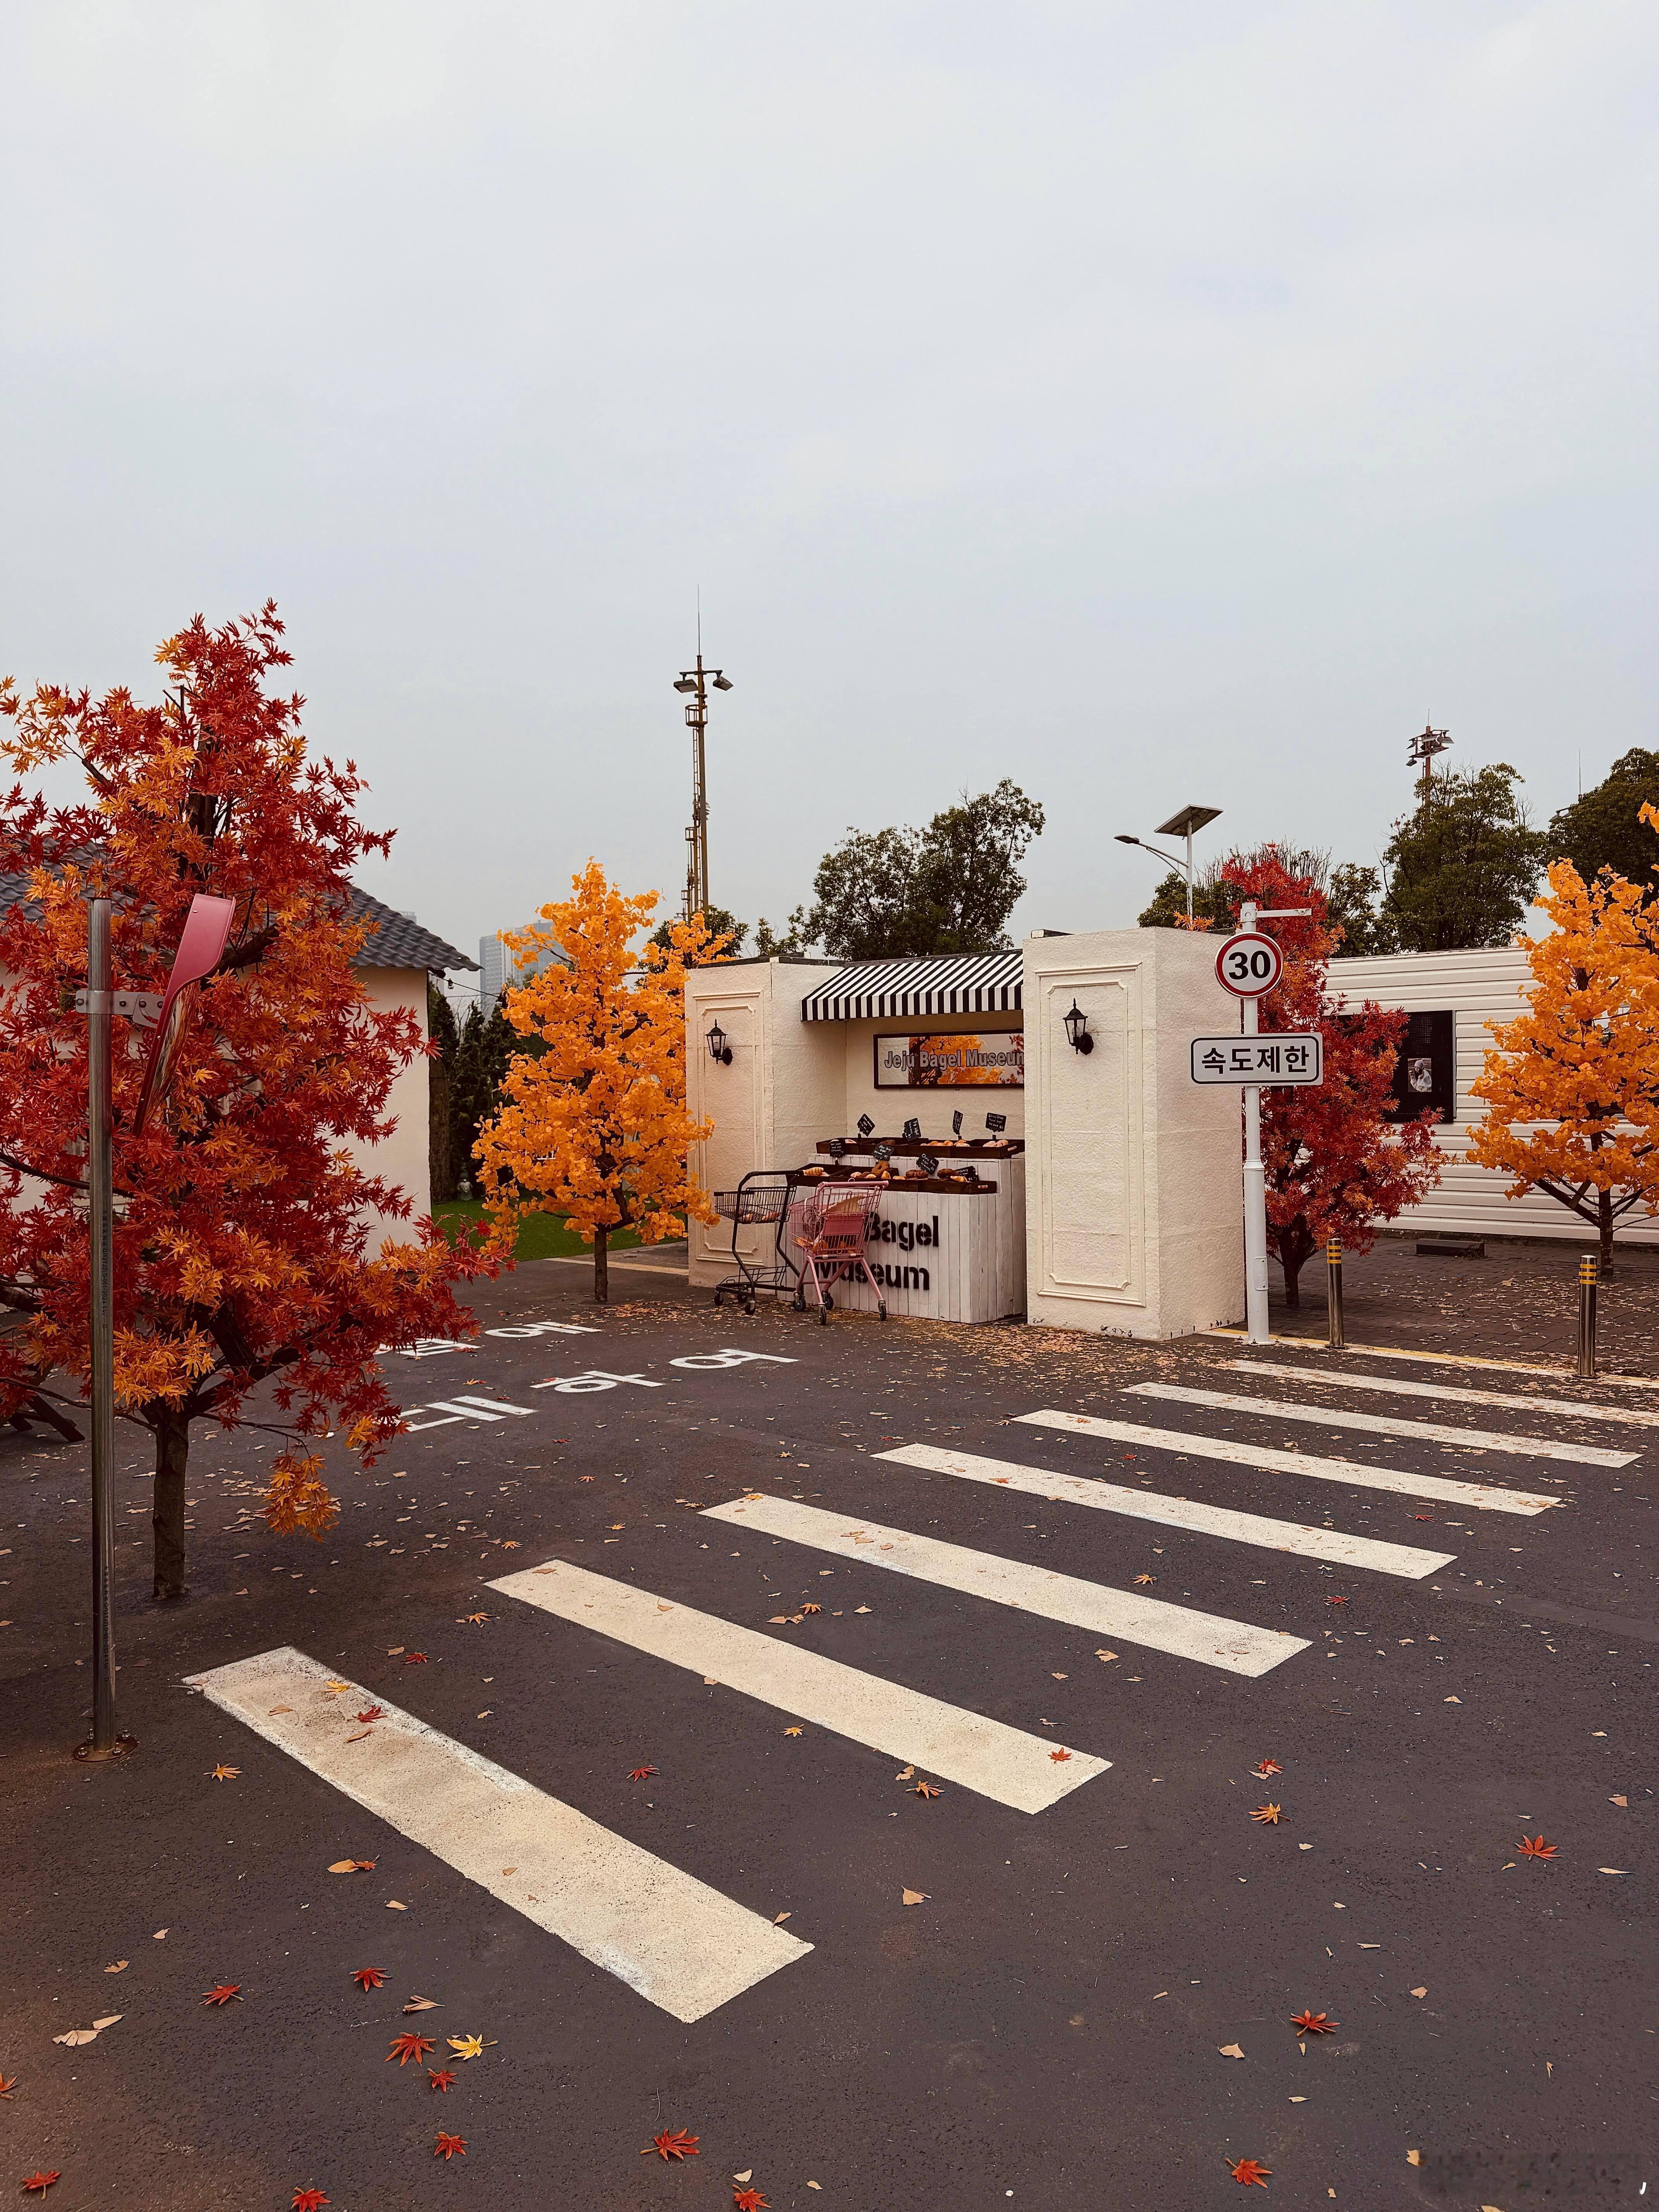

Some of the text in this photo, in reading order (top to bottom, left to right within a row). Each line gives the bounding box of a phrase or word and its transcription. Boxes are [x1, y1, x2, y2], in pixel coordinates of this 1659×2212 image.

[1228, 951, 1271, 980] 30
[884, 1051, 915, 1072] Jeju
[920, 1049, 961, 1071] Bagel
[1202, 1046, 1309, 1074] 속도제한
[864, 1211, 939, 1251] Bagel
[814, 1259, 929, 1290] Museum
